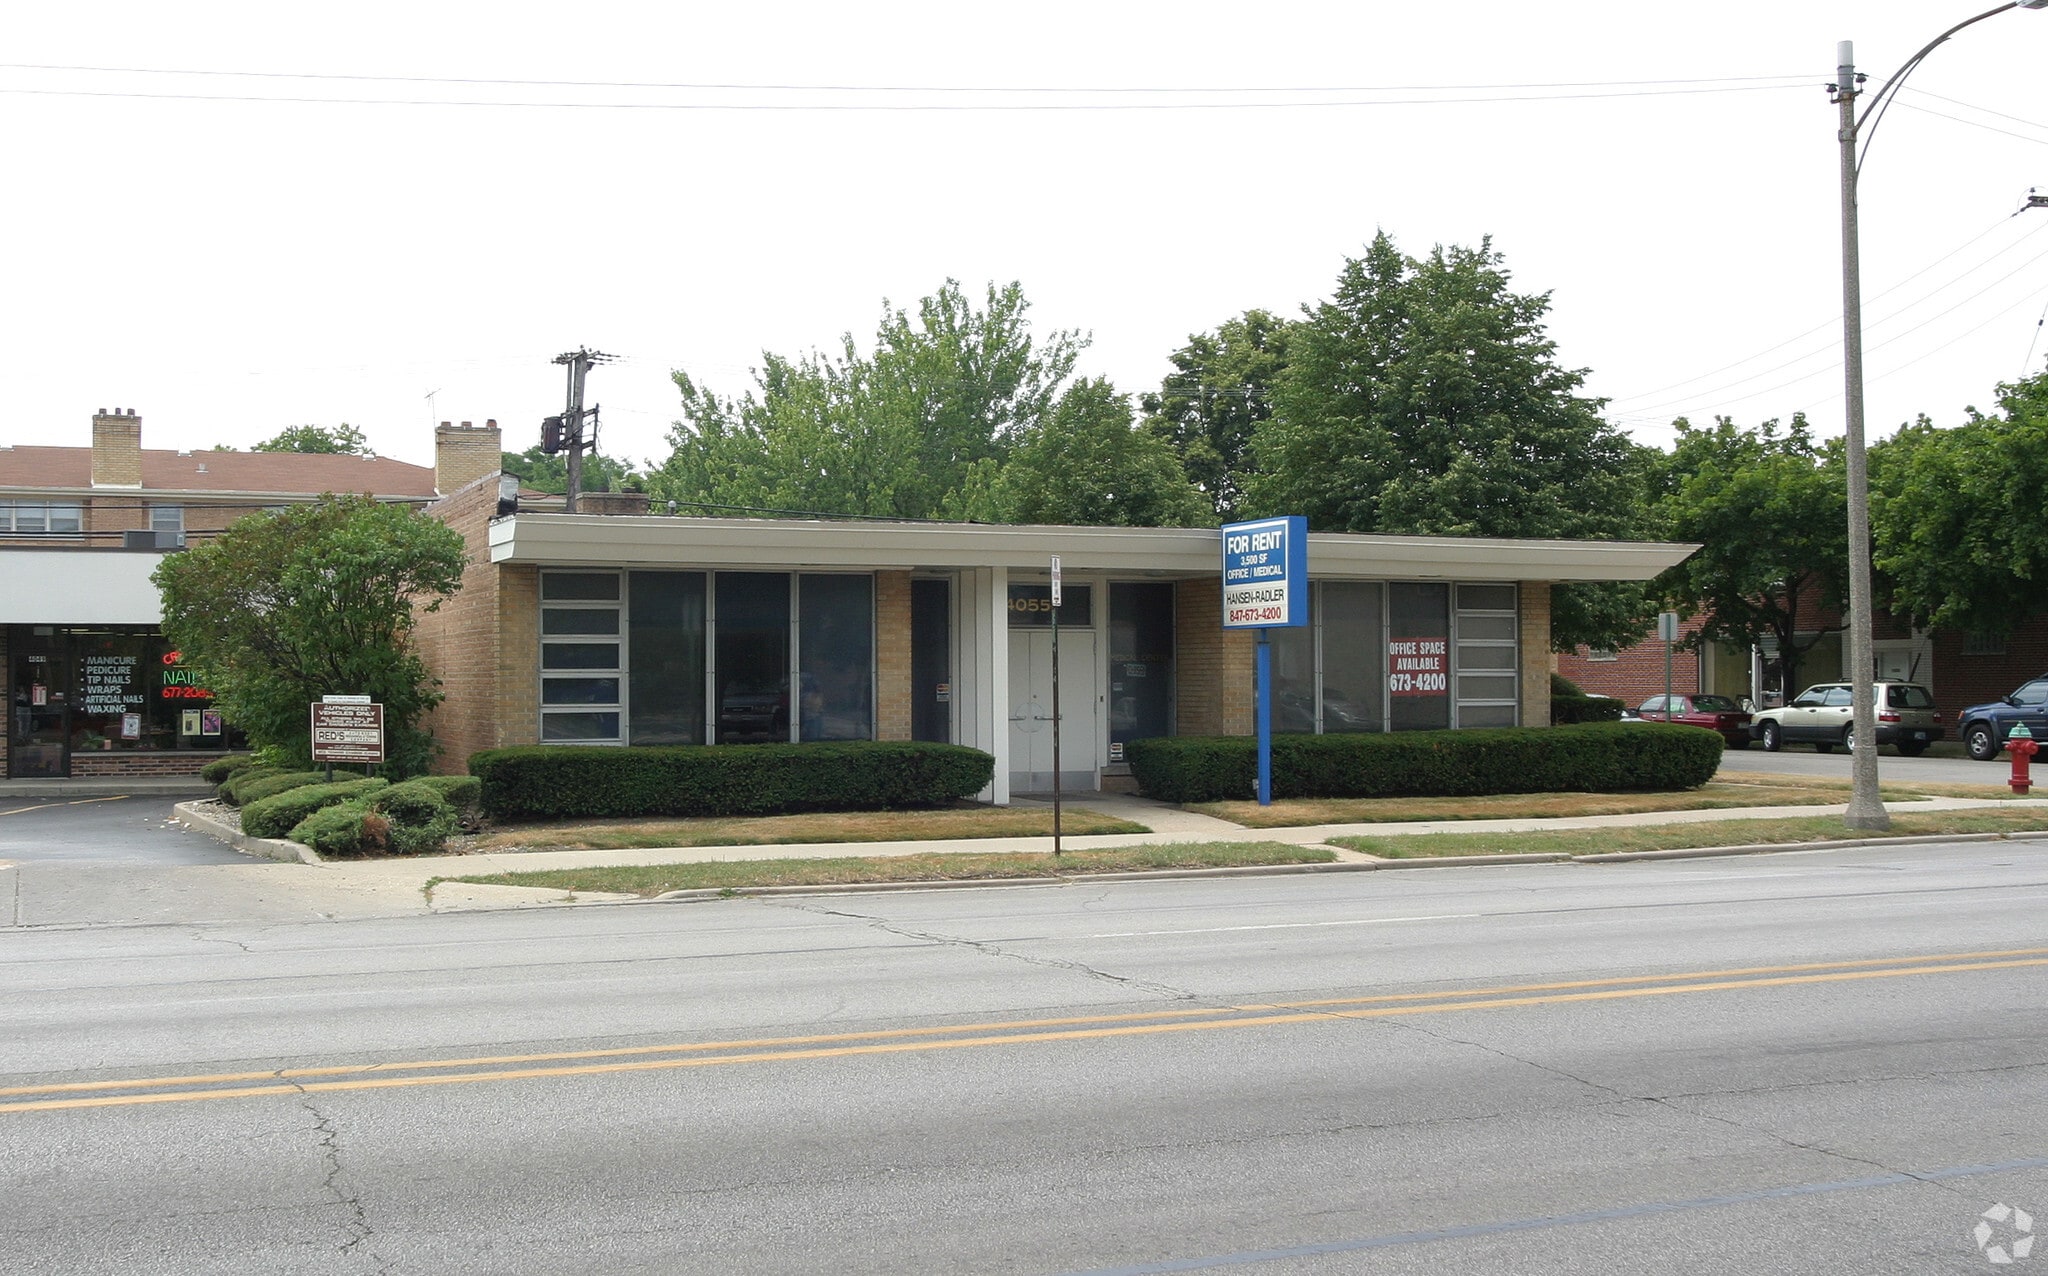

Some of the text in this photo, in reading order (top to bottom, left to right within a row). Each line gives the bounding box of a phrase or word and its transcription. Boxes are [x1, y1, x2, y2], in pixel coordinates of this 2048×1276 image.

[1227, 531, 1282, 554] FOR RENT
[1240, 553, 1268, 566] 3,500 SF
[1227, 568, 1249, 580] OFFICE
[1253, 565, 1282, 577] MEDICAL
[1226, 589, 1284, 605] HANSEN-RADLER
[1229, 606, 1282, 622] 847-673-4200
[1390, 642, 1446, 655] OFFICE SPACE
[86, 656, 137, 665] MANICURE
[1397, 657, 1440, 670] AVAILABLE
[86, 666, 132, 675] PEDICURE
[87, 675, 131, 684] TIP NAILS
[1390, 673, 1446, 691] 673-4200
[87, 685, 122, 694] WRAPS
[85, 695, 144, 704] ARTIFICIAL NAILS
[87, 704, 127, 713] WAXING
[318, 731, 345, 740] RED'S
